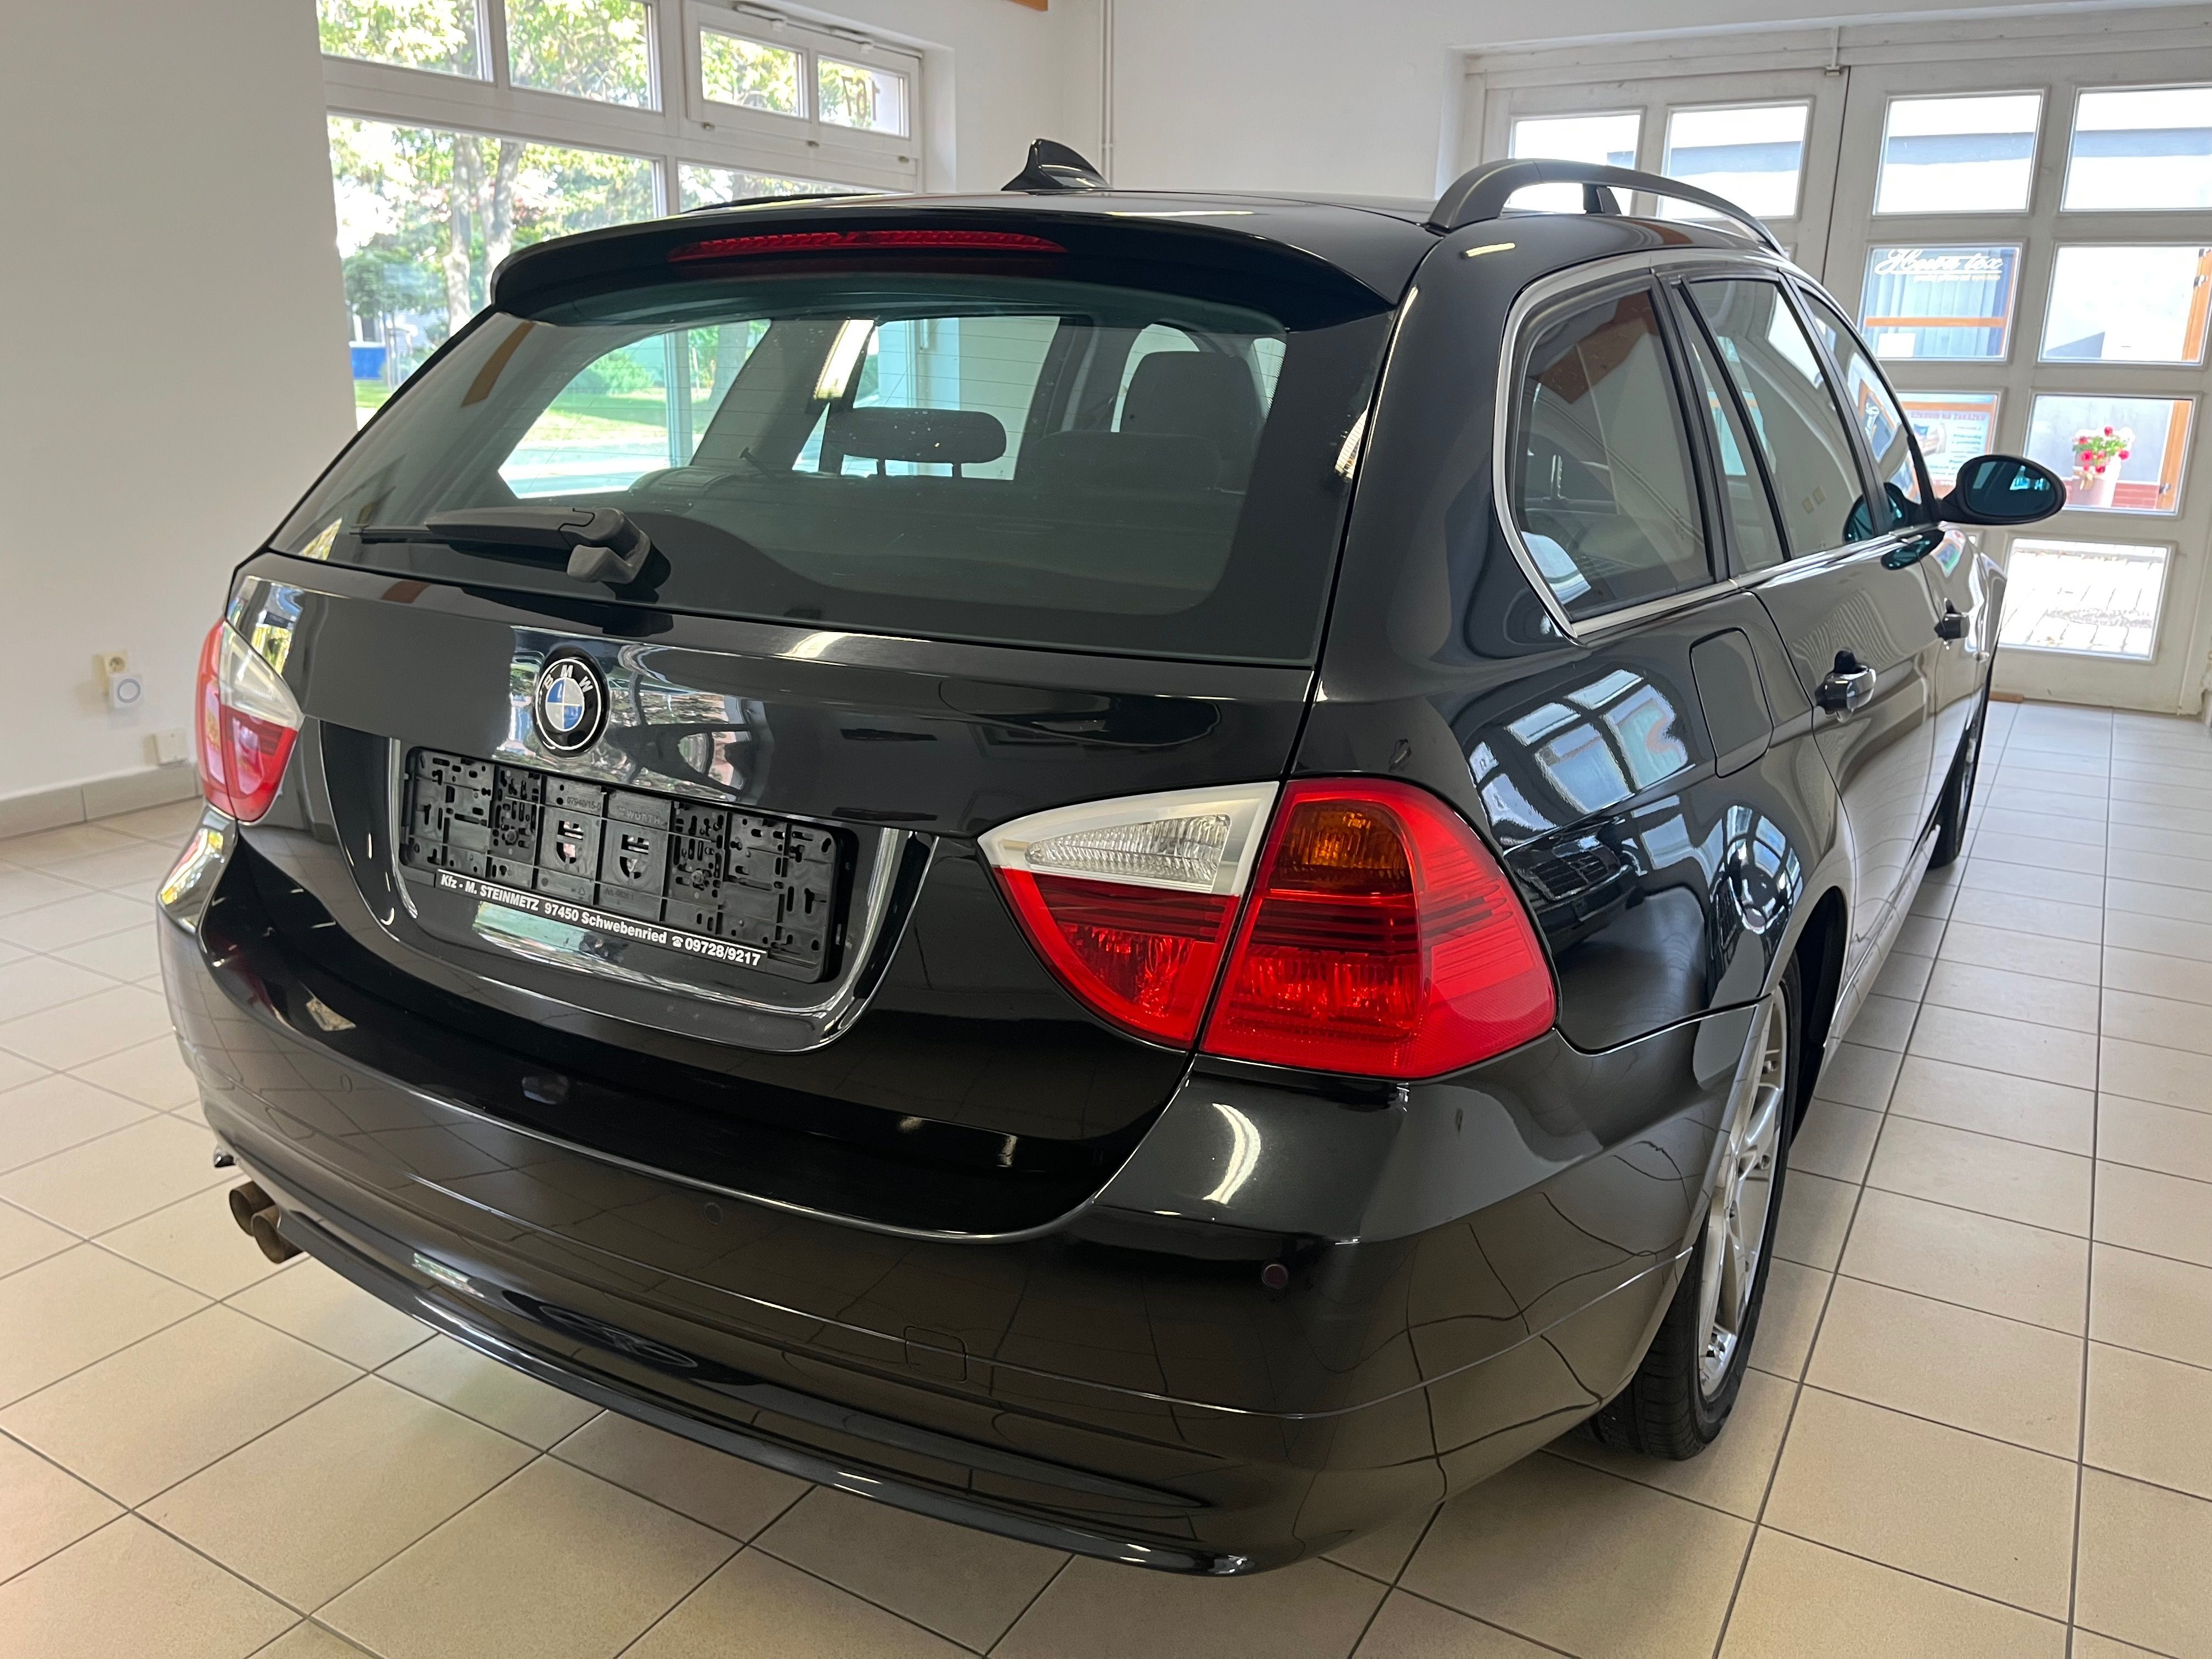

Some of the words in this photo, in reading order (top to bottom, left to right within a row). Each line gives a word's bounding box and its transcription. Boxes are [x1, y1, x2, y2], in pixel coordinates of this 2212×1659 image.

[543, 664, 593, 692] BMW
[441, 874, 457, 888] Kfz
[465, 881, 477, 894] M.
[480, 887, 539, 911] STEINMETZ
[545, 902, 579, 922] 97450
[582, 912, 668, 944] Schwebenried
[685, 938, 761, 966] 09728/9217
